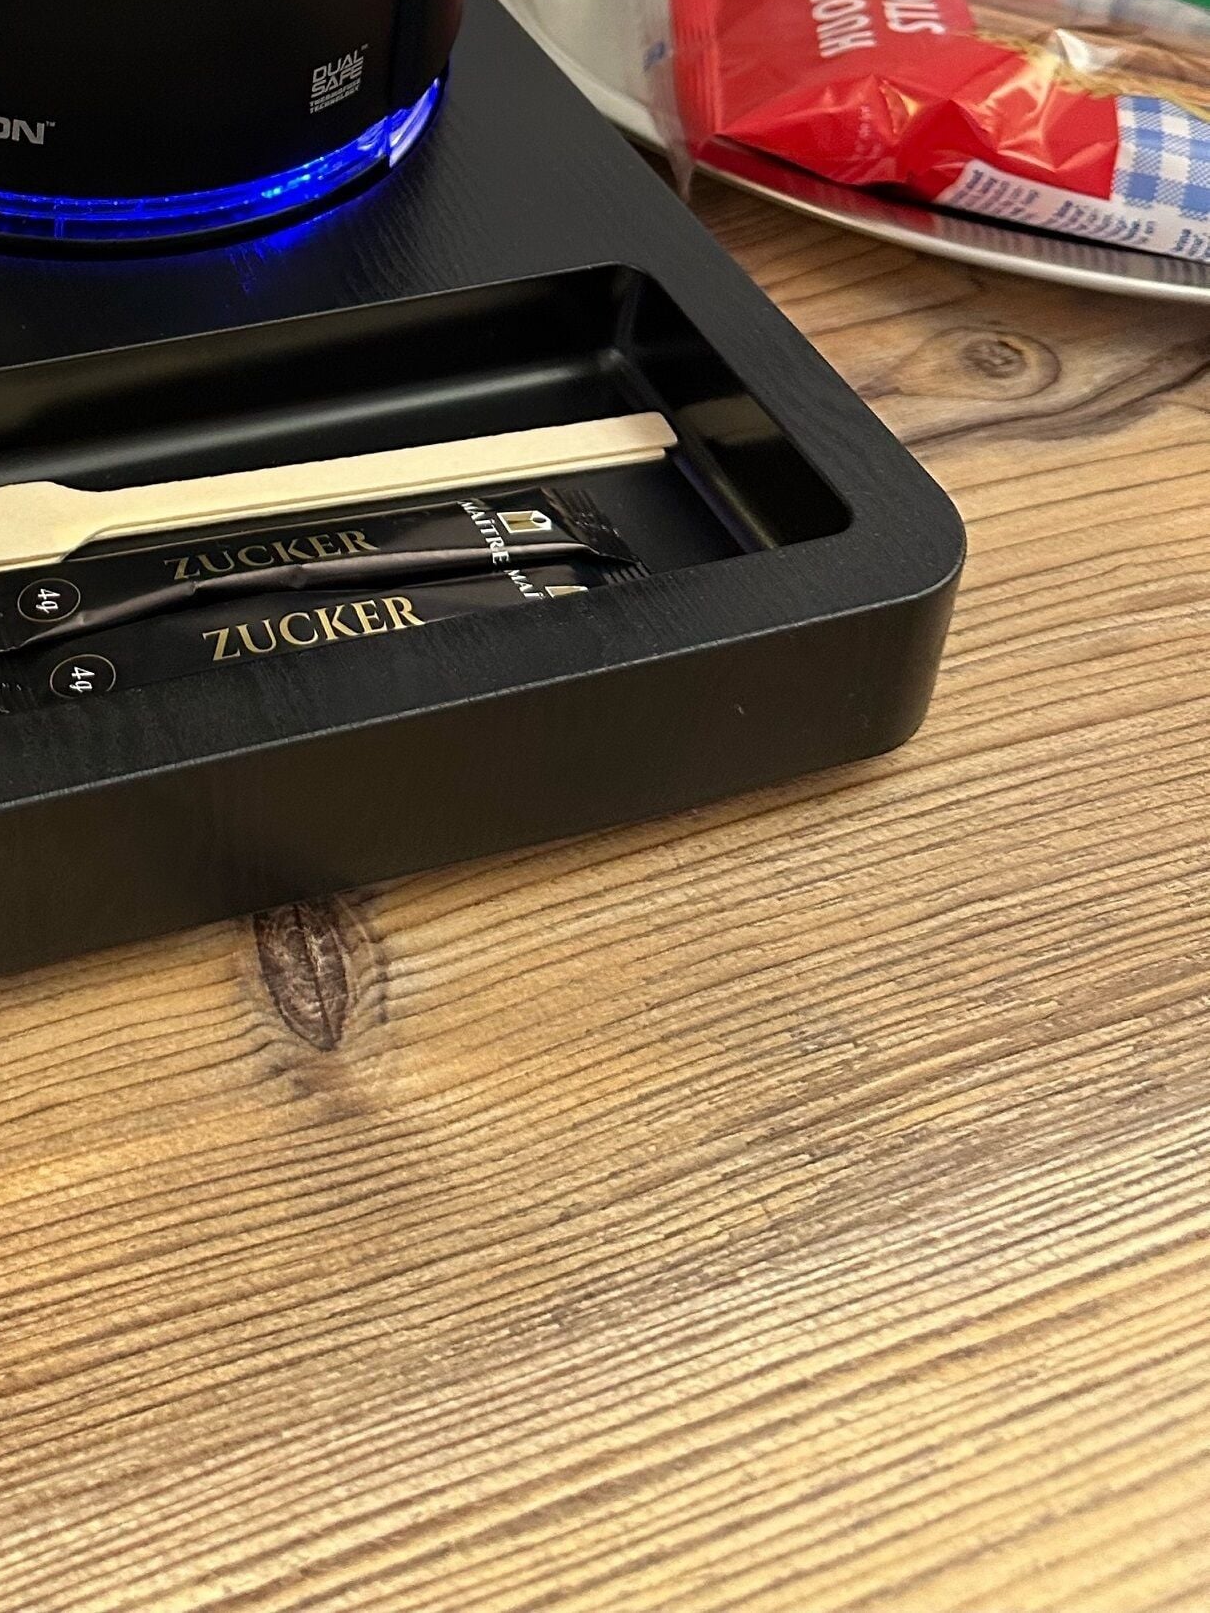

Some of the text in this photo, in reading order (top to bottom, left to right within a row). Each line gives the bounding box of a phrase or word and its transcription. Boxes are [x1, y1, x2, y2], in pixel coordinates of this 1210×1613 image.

[311, 60, 364, 99] SAFE
[163, 530, 380, 581] ZUCKER
[35, 588, 61, 614] 4g
[201, 594, 427, 662] ZUCKER
[69, 666, 95, 693] 4g
